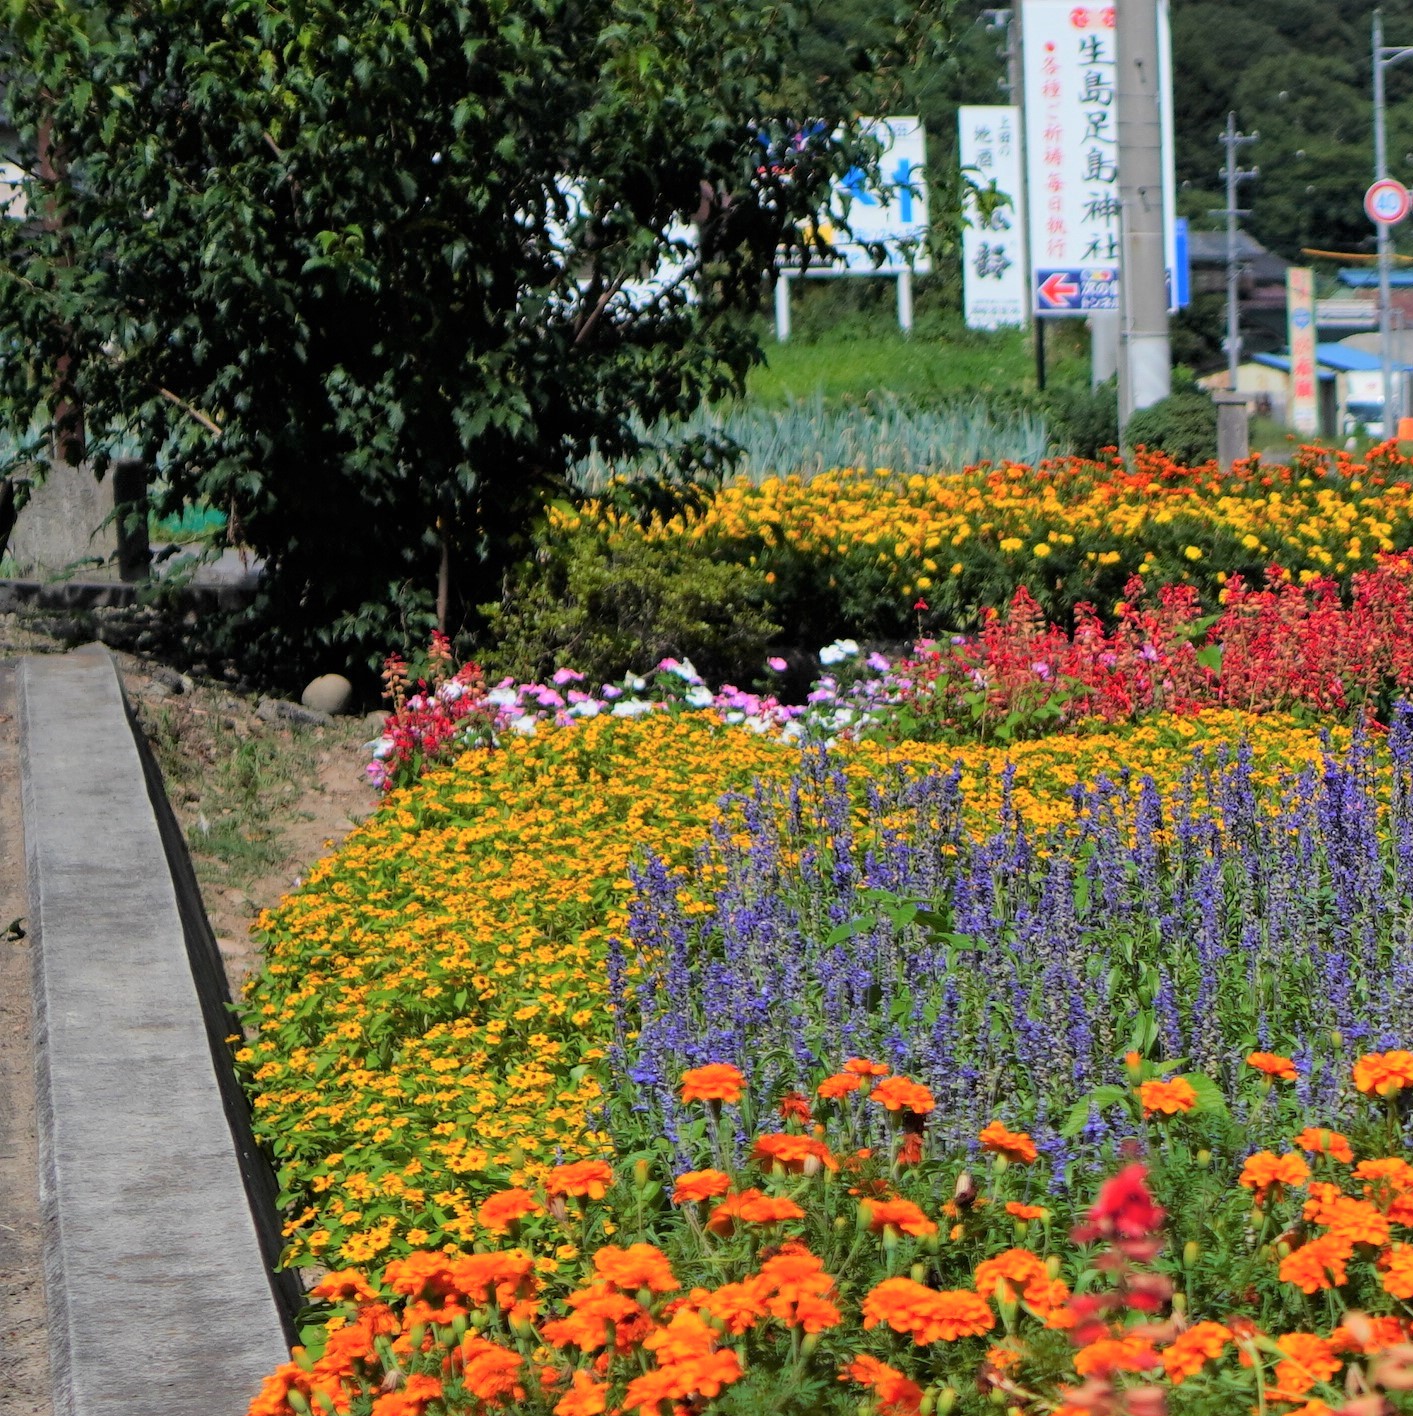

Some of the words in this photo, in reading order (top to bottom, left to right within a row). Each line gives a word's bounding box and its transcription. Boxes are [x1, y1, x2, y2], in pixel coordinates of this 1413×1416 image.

[1078, 35, 1121, 261] 生島足島神社
[1377, 192, 1398, 208] 40
